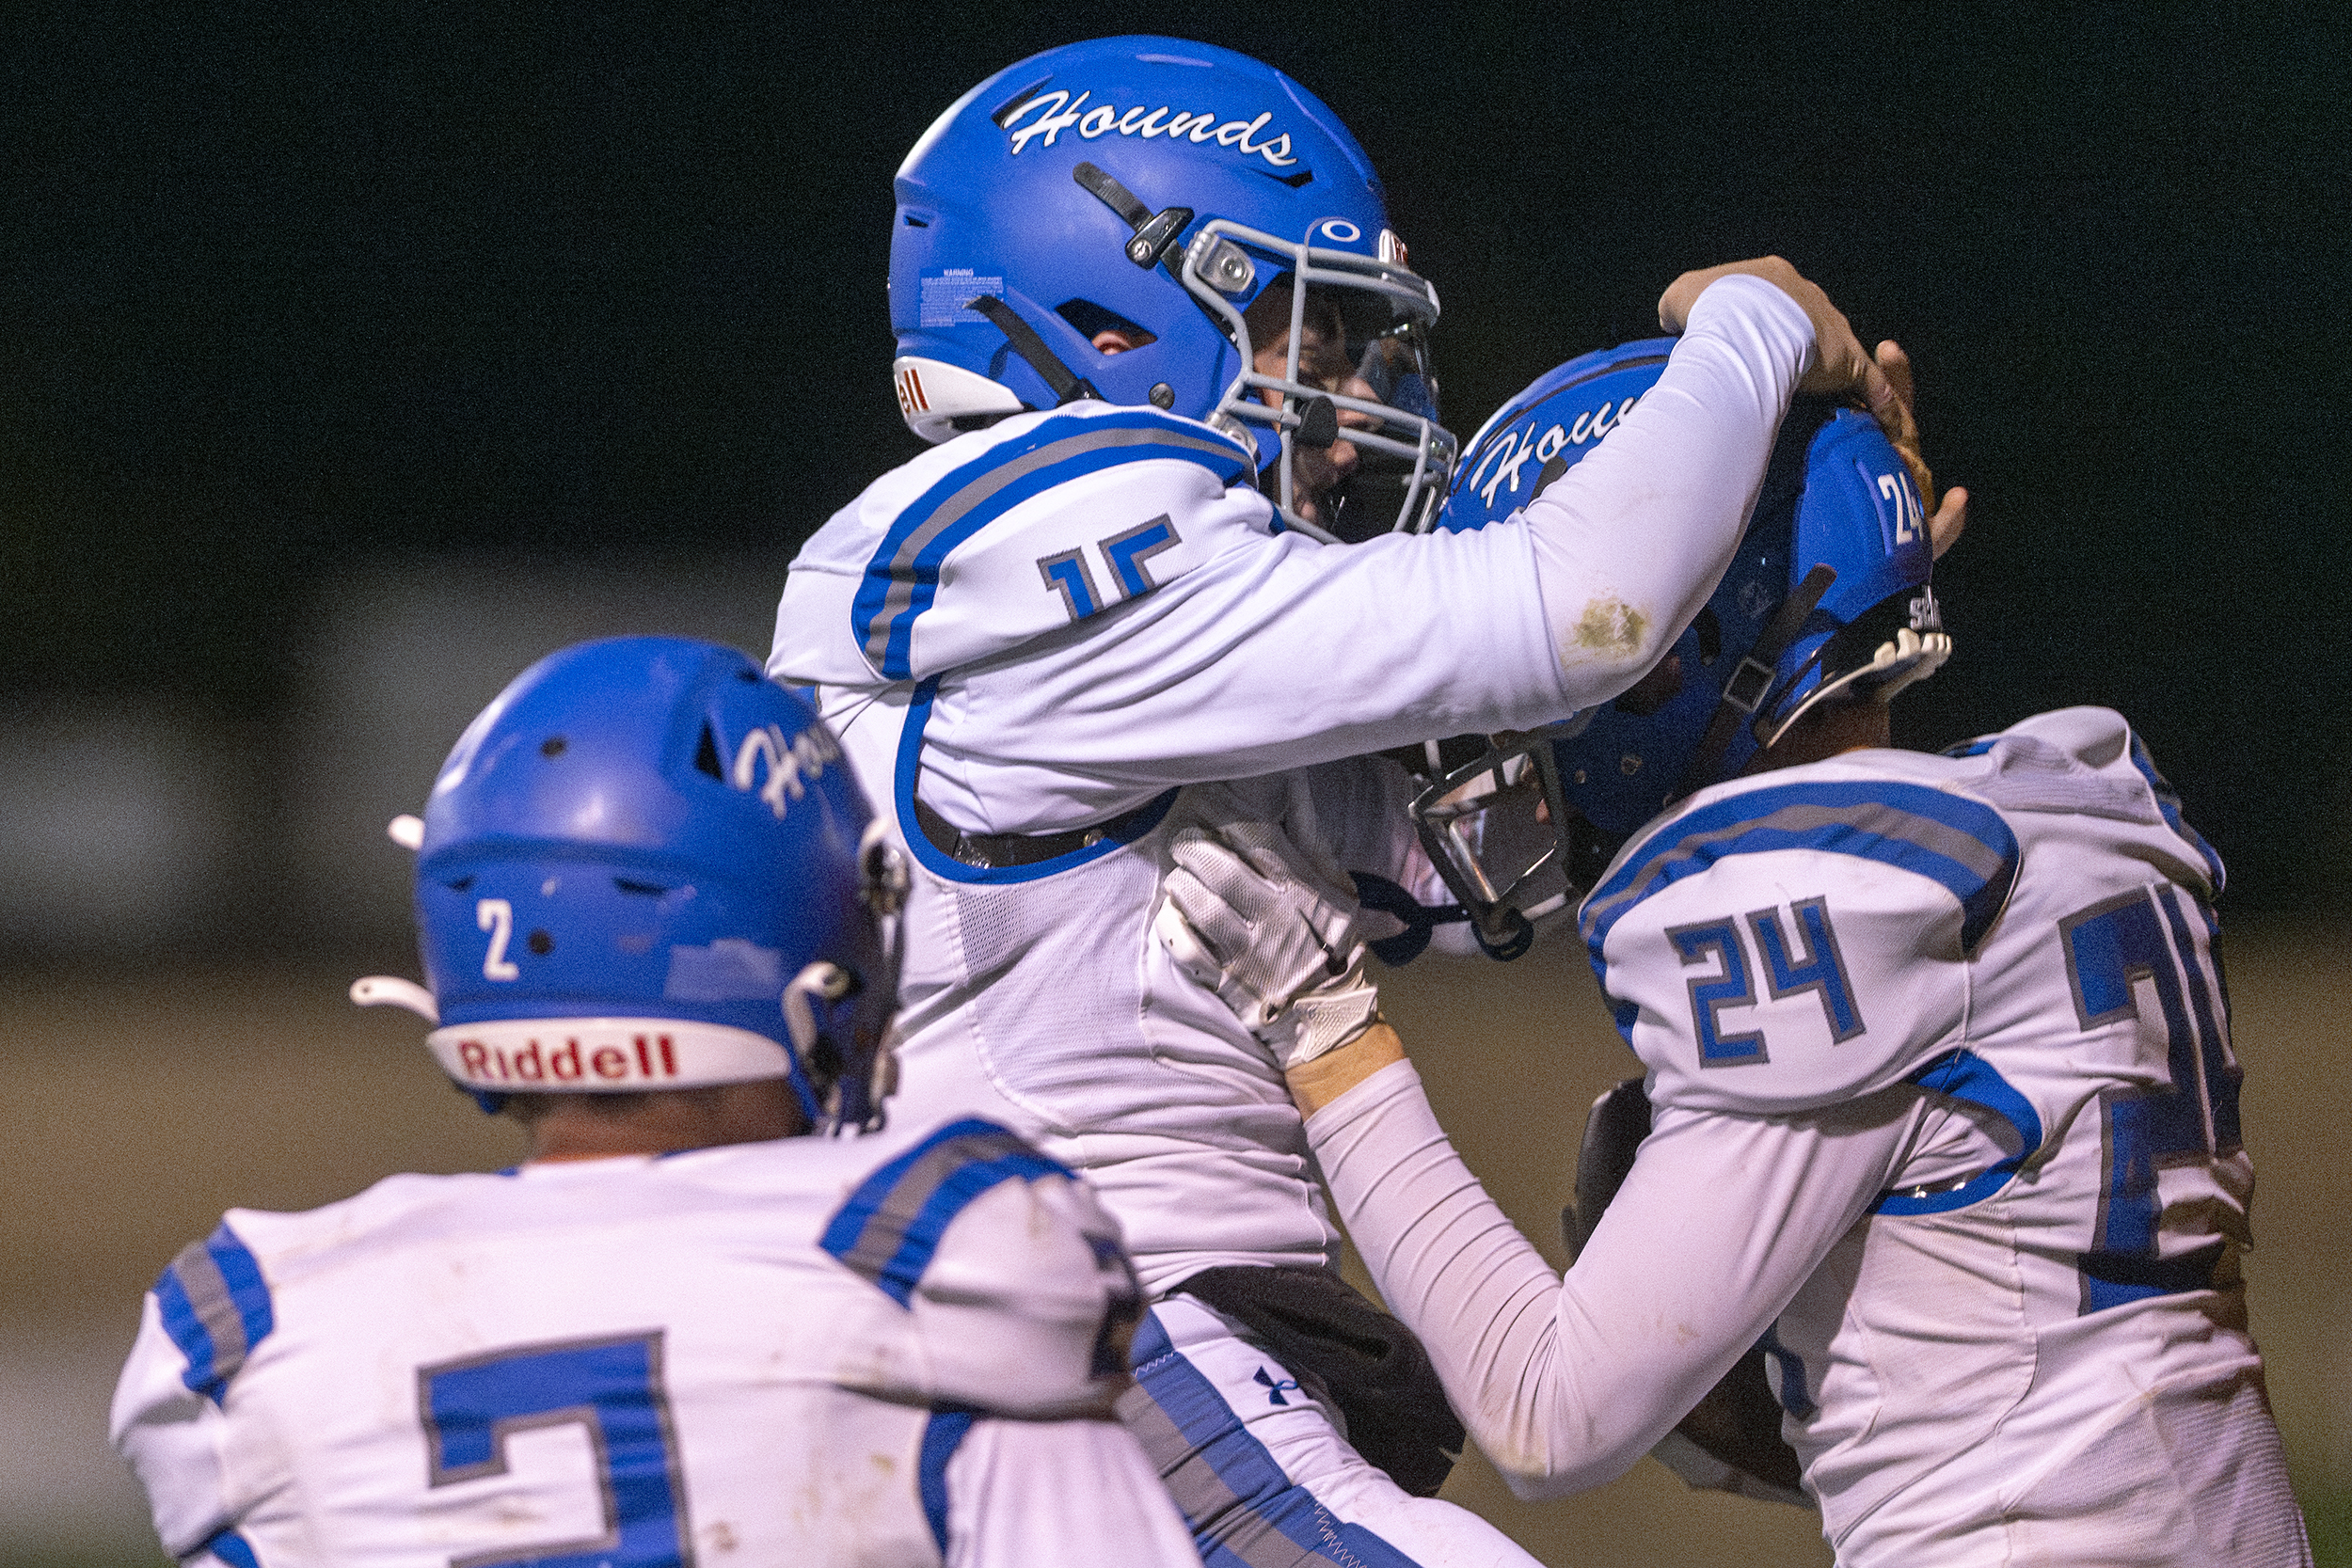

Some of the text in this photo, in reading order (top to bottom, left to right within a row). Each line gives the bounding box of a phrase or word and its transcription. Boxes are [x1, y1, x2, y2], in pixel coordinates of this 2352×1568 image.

[1003, 88, 1297, 166] Hounds
[1877, 470, 1924, 546] 24
[477, 898, 520, 982] 2
[1664, 894, 1867, 1070] 24
[456, 1034, 679, 1084] Riddell
